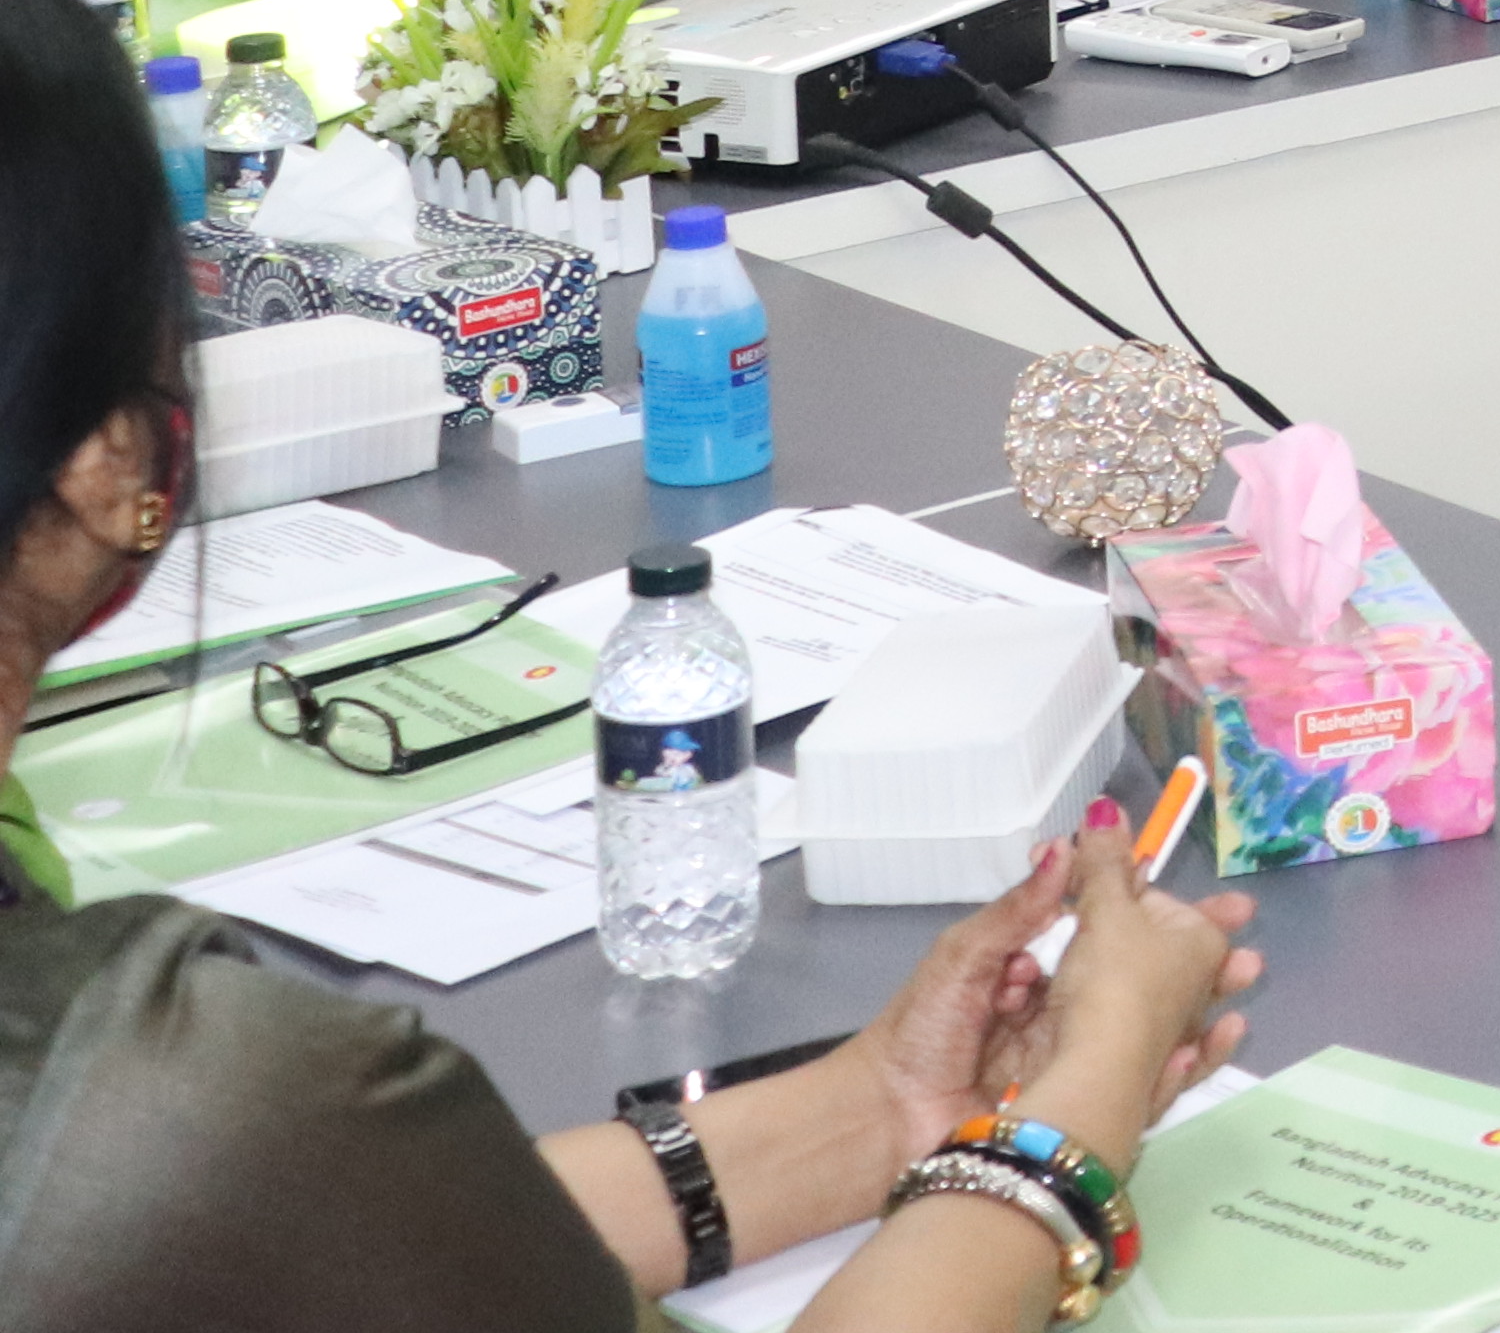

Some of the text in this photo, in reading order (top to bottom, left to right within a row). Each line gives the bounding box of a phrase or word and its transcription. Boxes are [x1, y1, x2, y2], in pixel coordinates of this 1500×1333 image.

[1306, 707, 1404, 734] Bashundhara
[1271, 1126, 1390, 1170] Bangladesh
[1391, 1163, 1491, 1200] Advocacy
[1291, 1155, 1386, 1192] Nutrition
[1210, 1202, 1407, 1271] Operationalization
[1243, 1188, 1431, 1253] Framework for its
